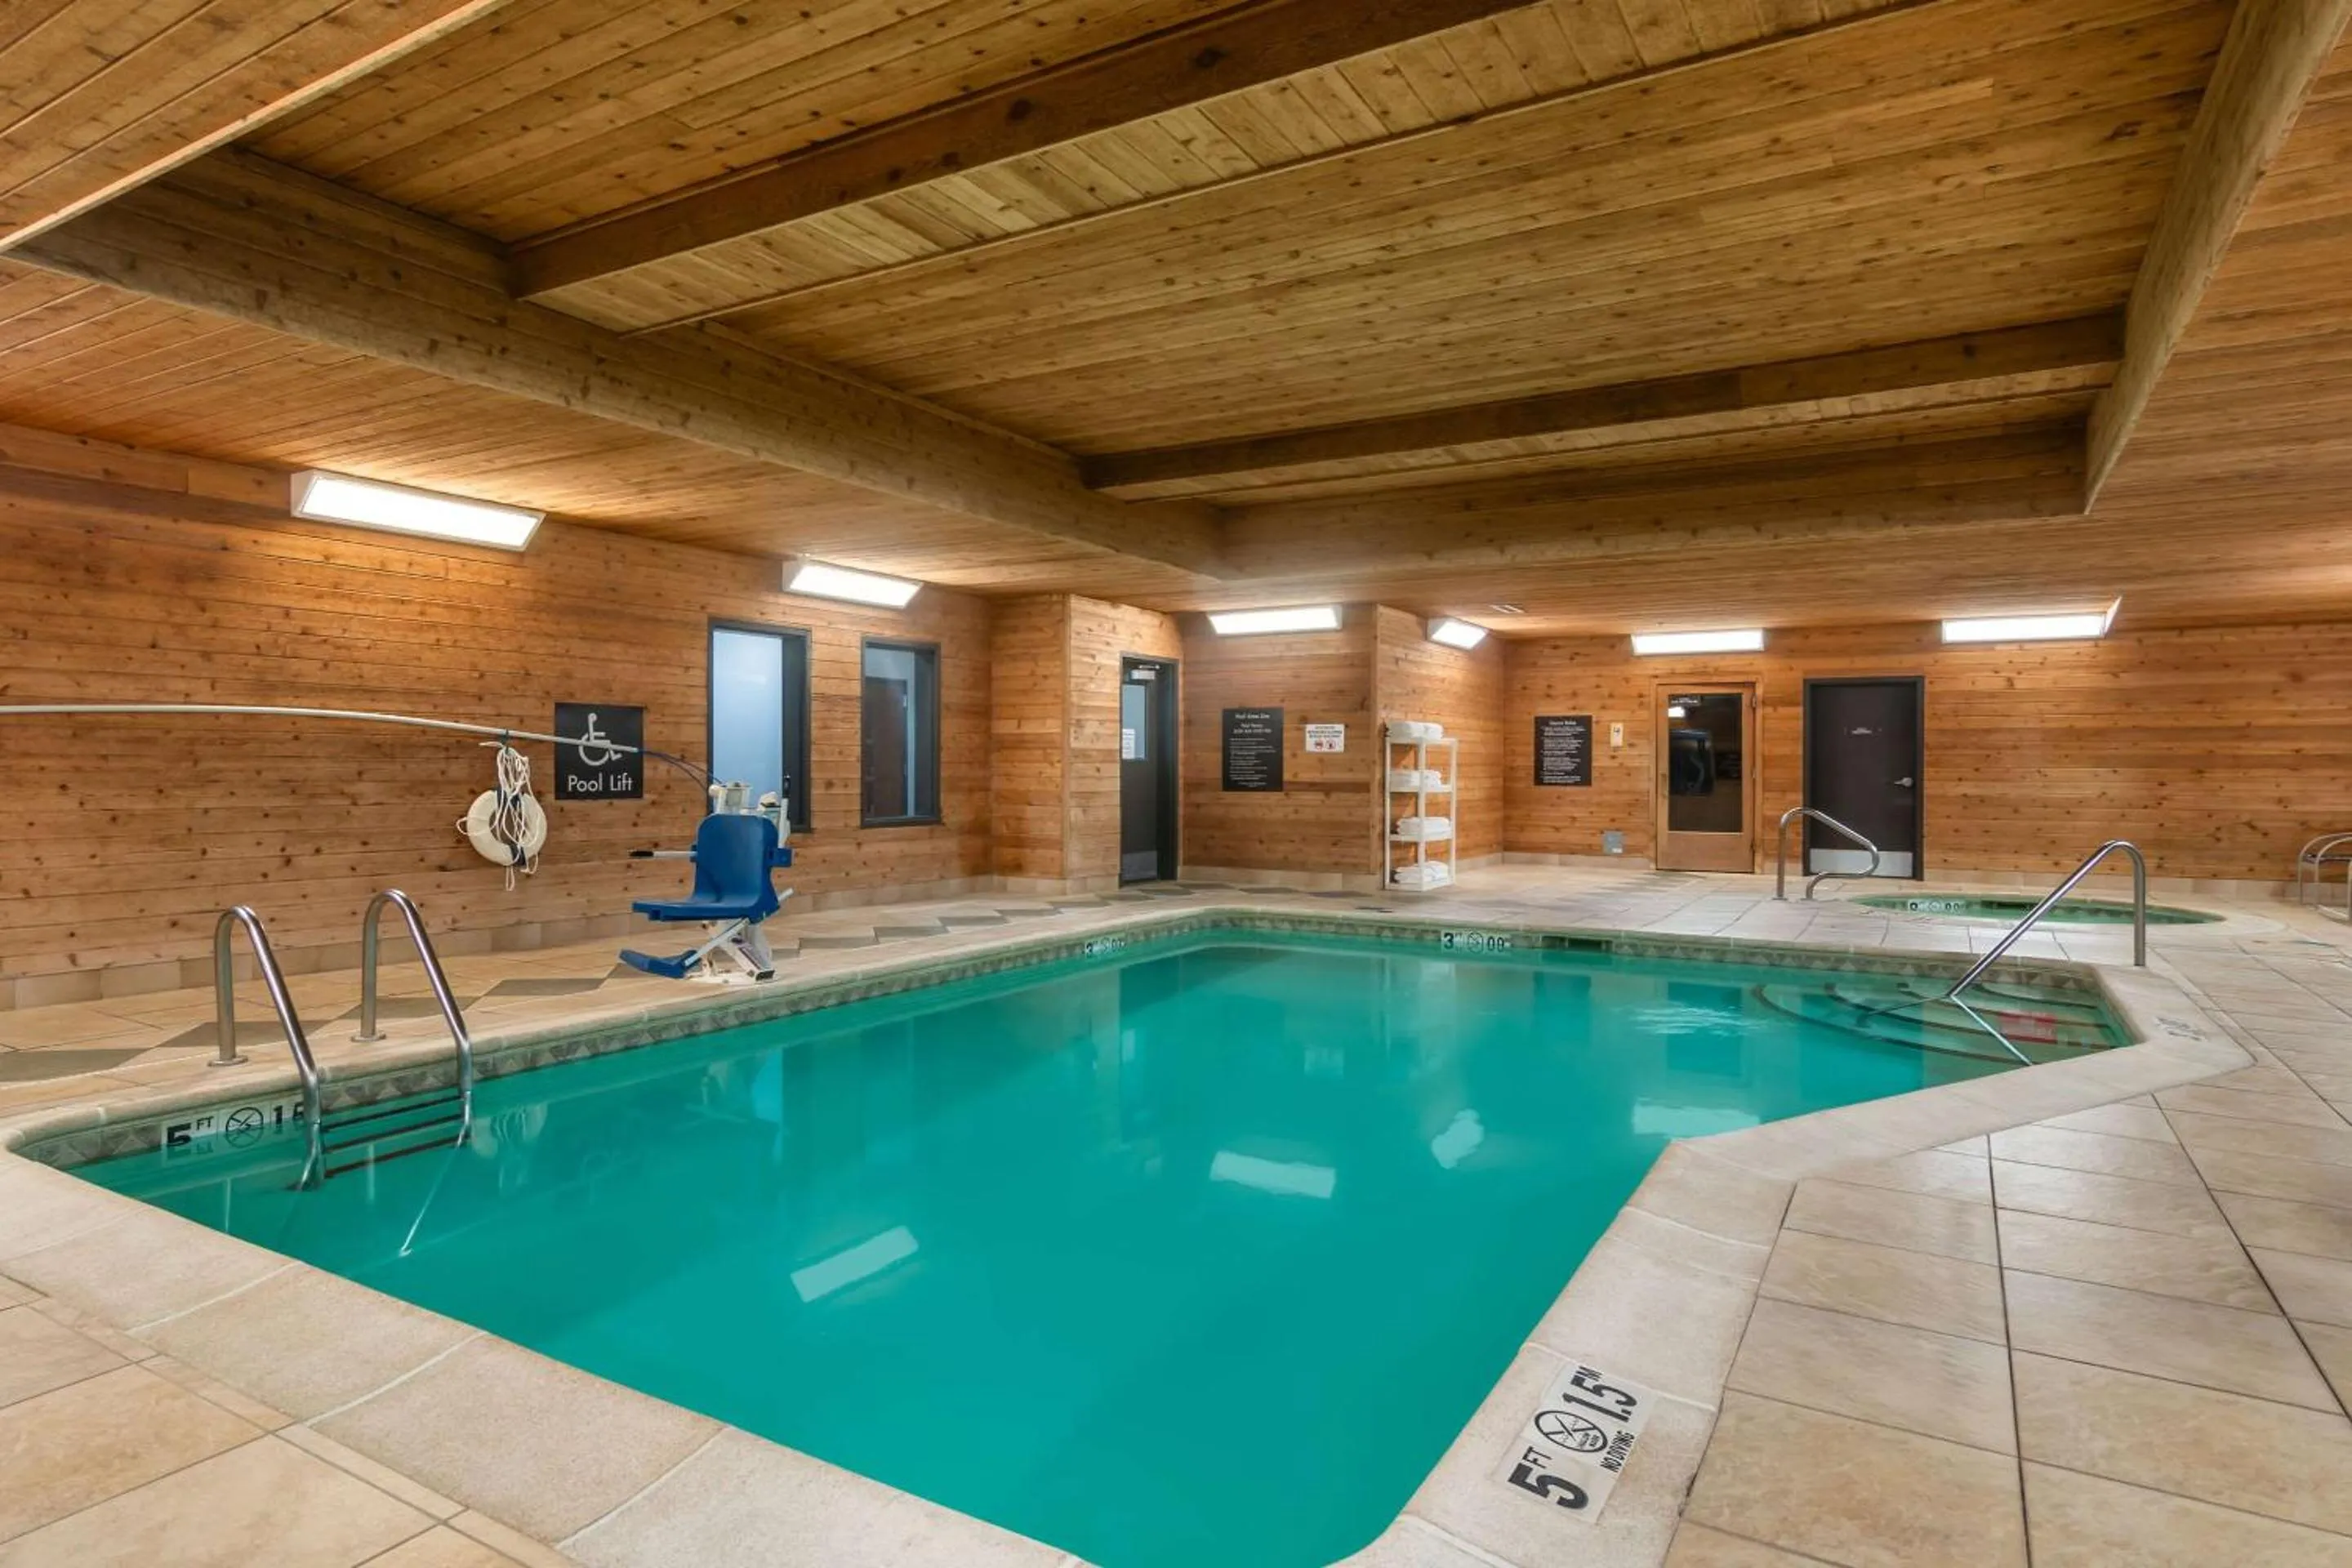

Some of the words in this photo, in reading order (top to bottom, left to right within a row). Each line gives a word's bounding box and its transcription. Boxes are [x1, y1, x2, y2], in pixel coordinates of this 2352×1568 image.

[568, 772, 603, 791] Pool
[610, 772, 634, 791] Lift
[166, 1122, 191, 1147] 5
[1561, 1374, 1637, 1423] 1.5
[1522, 1446, 1552, 1468] FT
[1608, 1429, 1634, 1463] DIVING
[1507, 1462, 1589, 1509] 5
